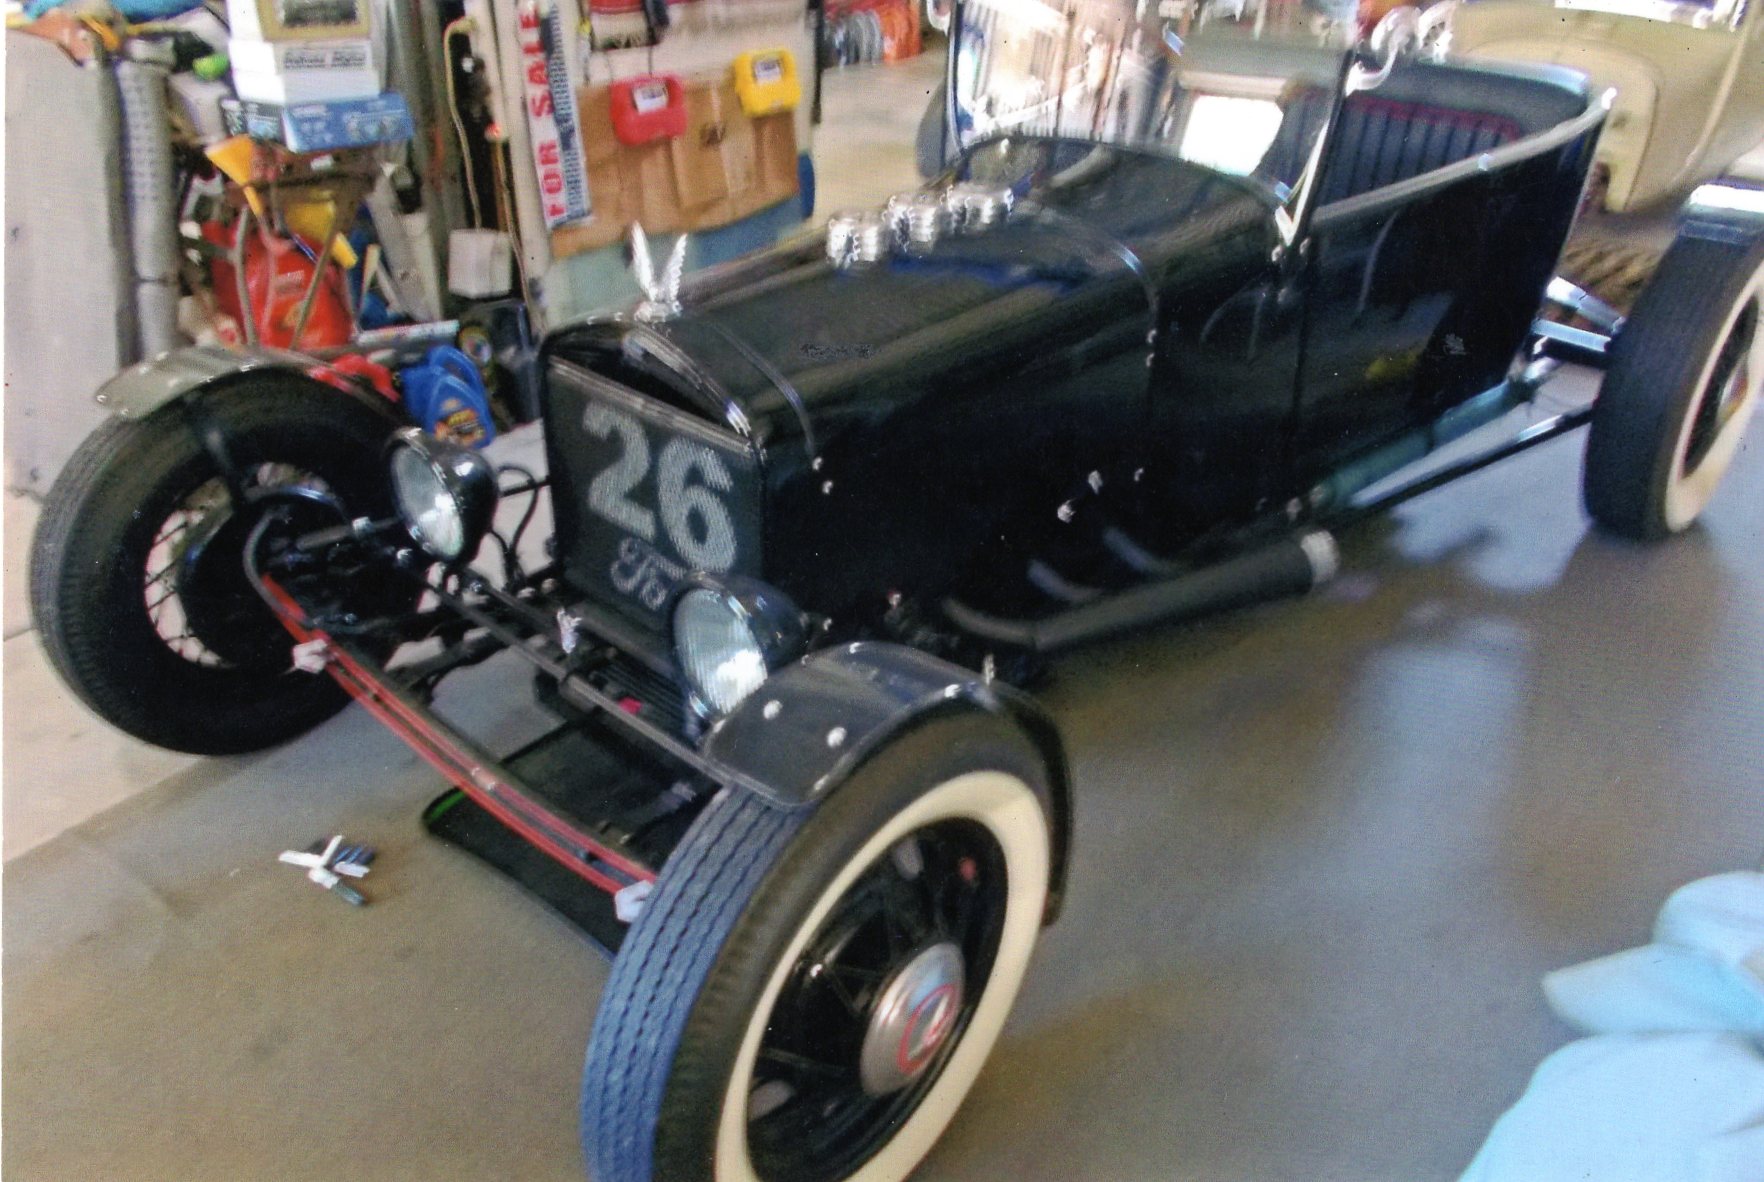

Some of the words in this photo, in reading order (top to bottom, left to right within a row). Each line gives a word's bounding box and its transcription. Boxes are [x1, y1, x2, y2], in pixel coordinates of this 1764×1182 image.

[519, 9, 554, 118] SALE
[538, 140, 566, 217] FOR
[582, 402, 738, 573] 26
